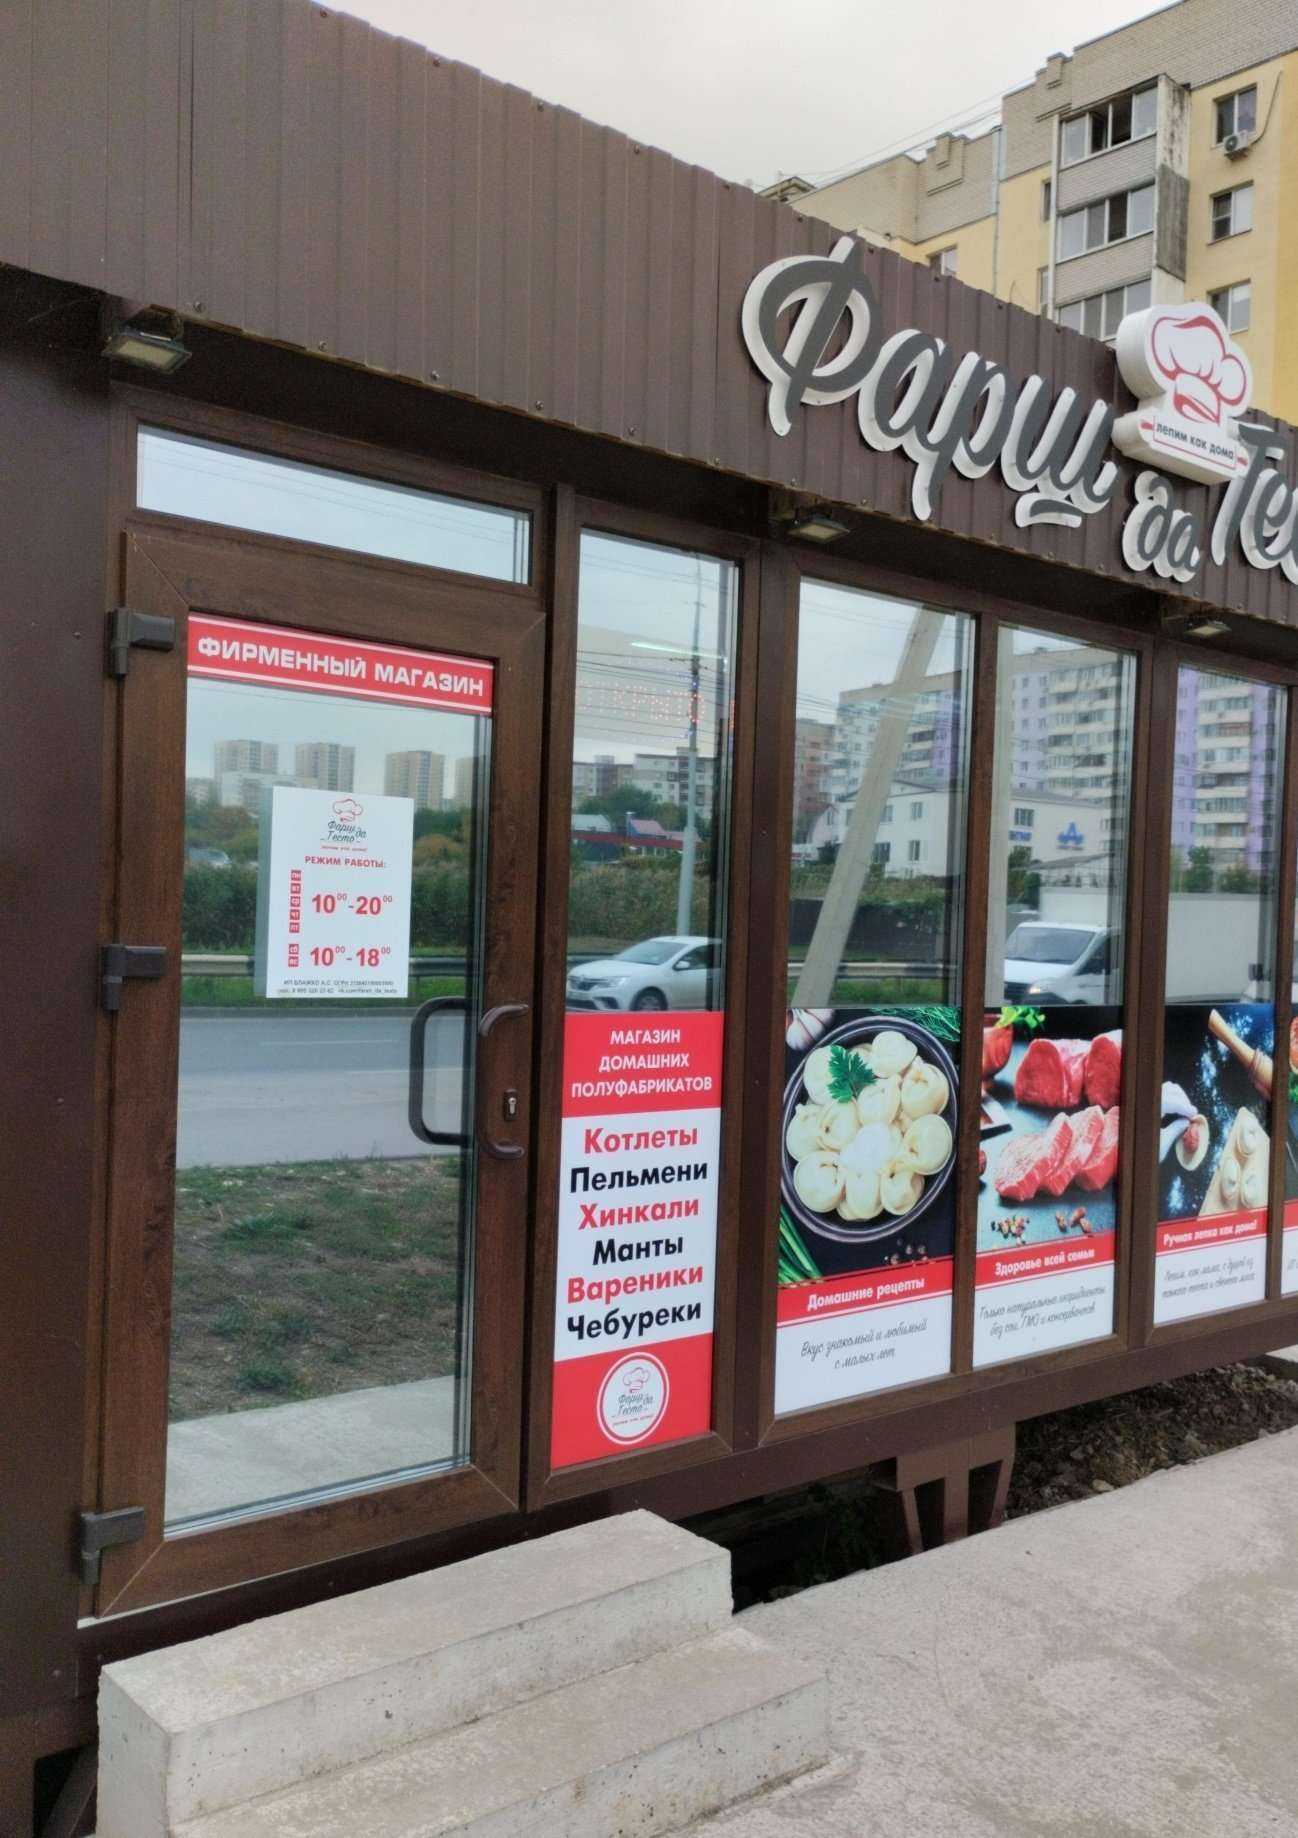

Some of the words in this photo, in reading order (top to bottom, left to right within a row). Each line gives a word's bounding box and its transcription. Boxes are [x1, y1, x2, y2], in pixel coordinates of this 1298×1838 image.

[742, 235, 1120, 527] Фарш
[1123, 470, 1201, 583] да
[1156, 422, 1188, 440] лепим
[1190, 434, 1207, 450] как
[1209, 443, 1235, 460] дома
[198, 636, 367, 679] ФИРМЕННЫЙ
[374, 662, 484, 697] МАГАЗИН
[304, 855, 341, 866] РЕЖИМ
[610, 1029, 681, 1045] МАГАЗИН
[598, 1053, 690, 1073] ДОМАШНИХ
[571, 1077, 713, 1098] ПОЛУФАБРИКАТОВ
[584, 1128, 698, 1154] Котлеты
[570, 1162, 708, 1193] Пельмени
[578, 1198, 699, 1231] Хинкали
[592, 1236, 684, 1266] Манты
[995, 1258, 1042, 1276] Здоровье
[1044, 1251, 1065, 1266] всей
[1067, 1248, 1095, 1262] семьи
[567, 1265, 703, 1305] Вареники
[806, 1287, 873, 1311] Домашние
[877, 1278, 925, 1300] рецепты
[567, 1301, 701, 1340] Чебуреки
[801, 1340, 823, 1362] Вкус
[826, 1329, 874, 1357] знакомый
[875, 1331, 882, 1342] и
[884, 1318, 928, 1338] любимый
[834, 1360, 840, 1370] с
[842, 1351, 874, 1369] малых
[877, 1348, 896, 1361] лет
